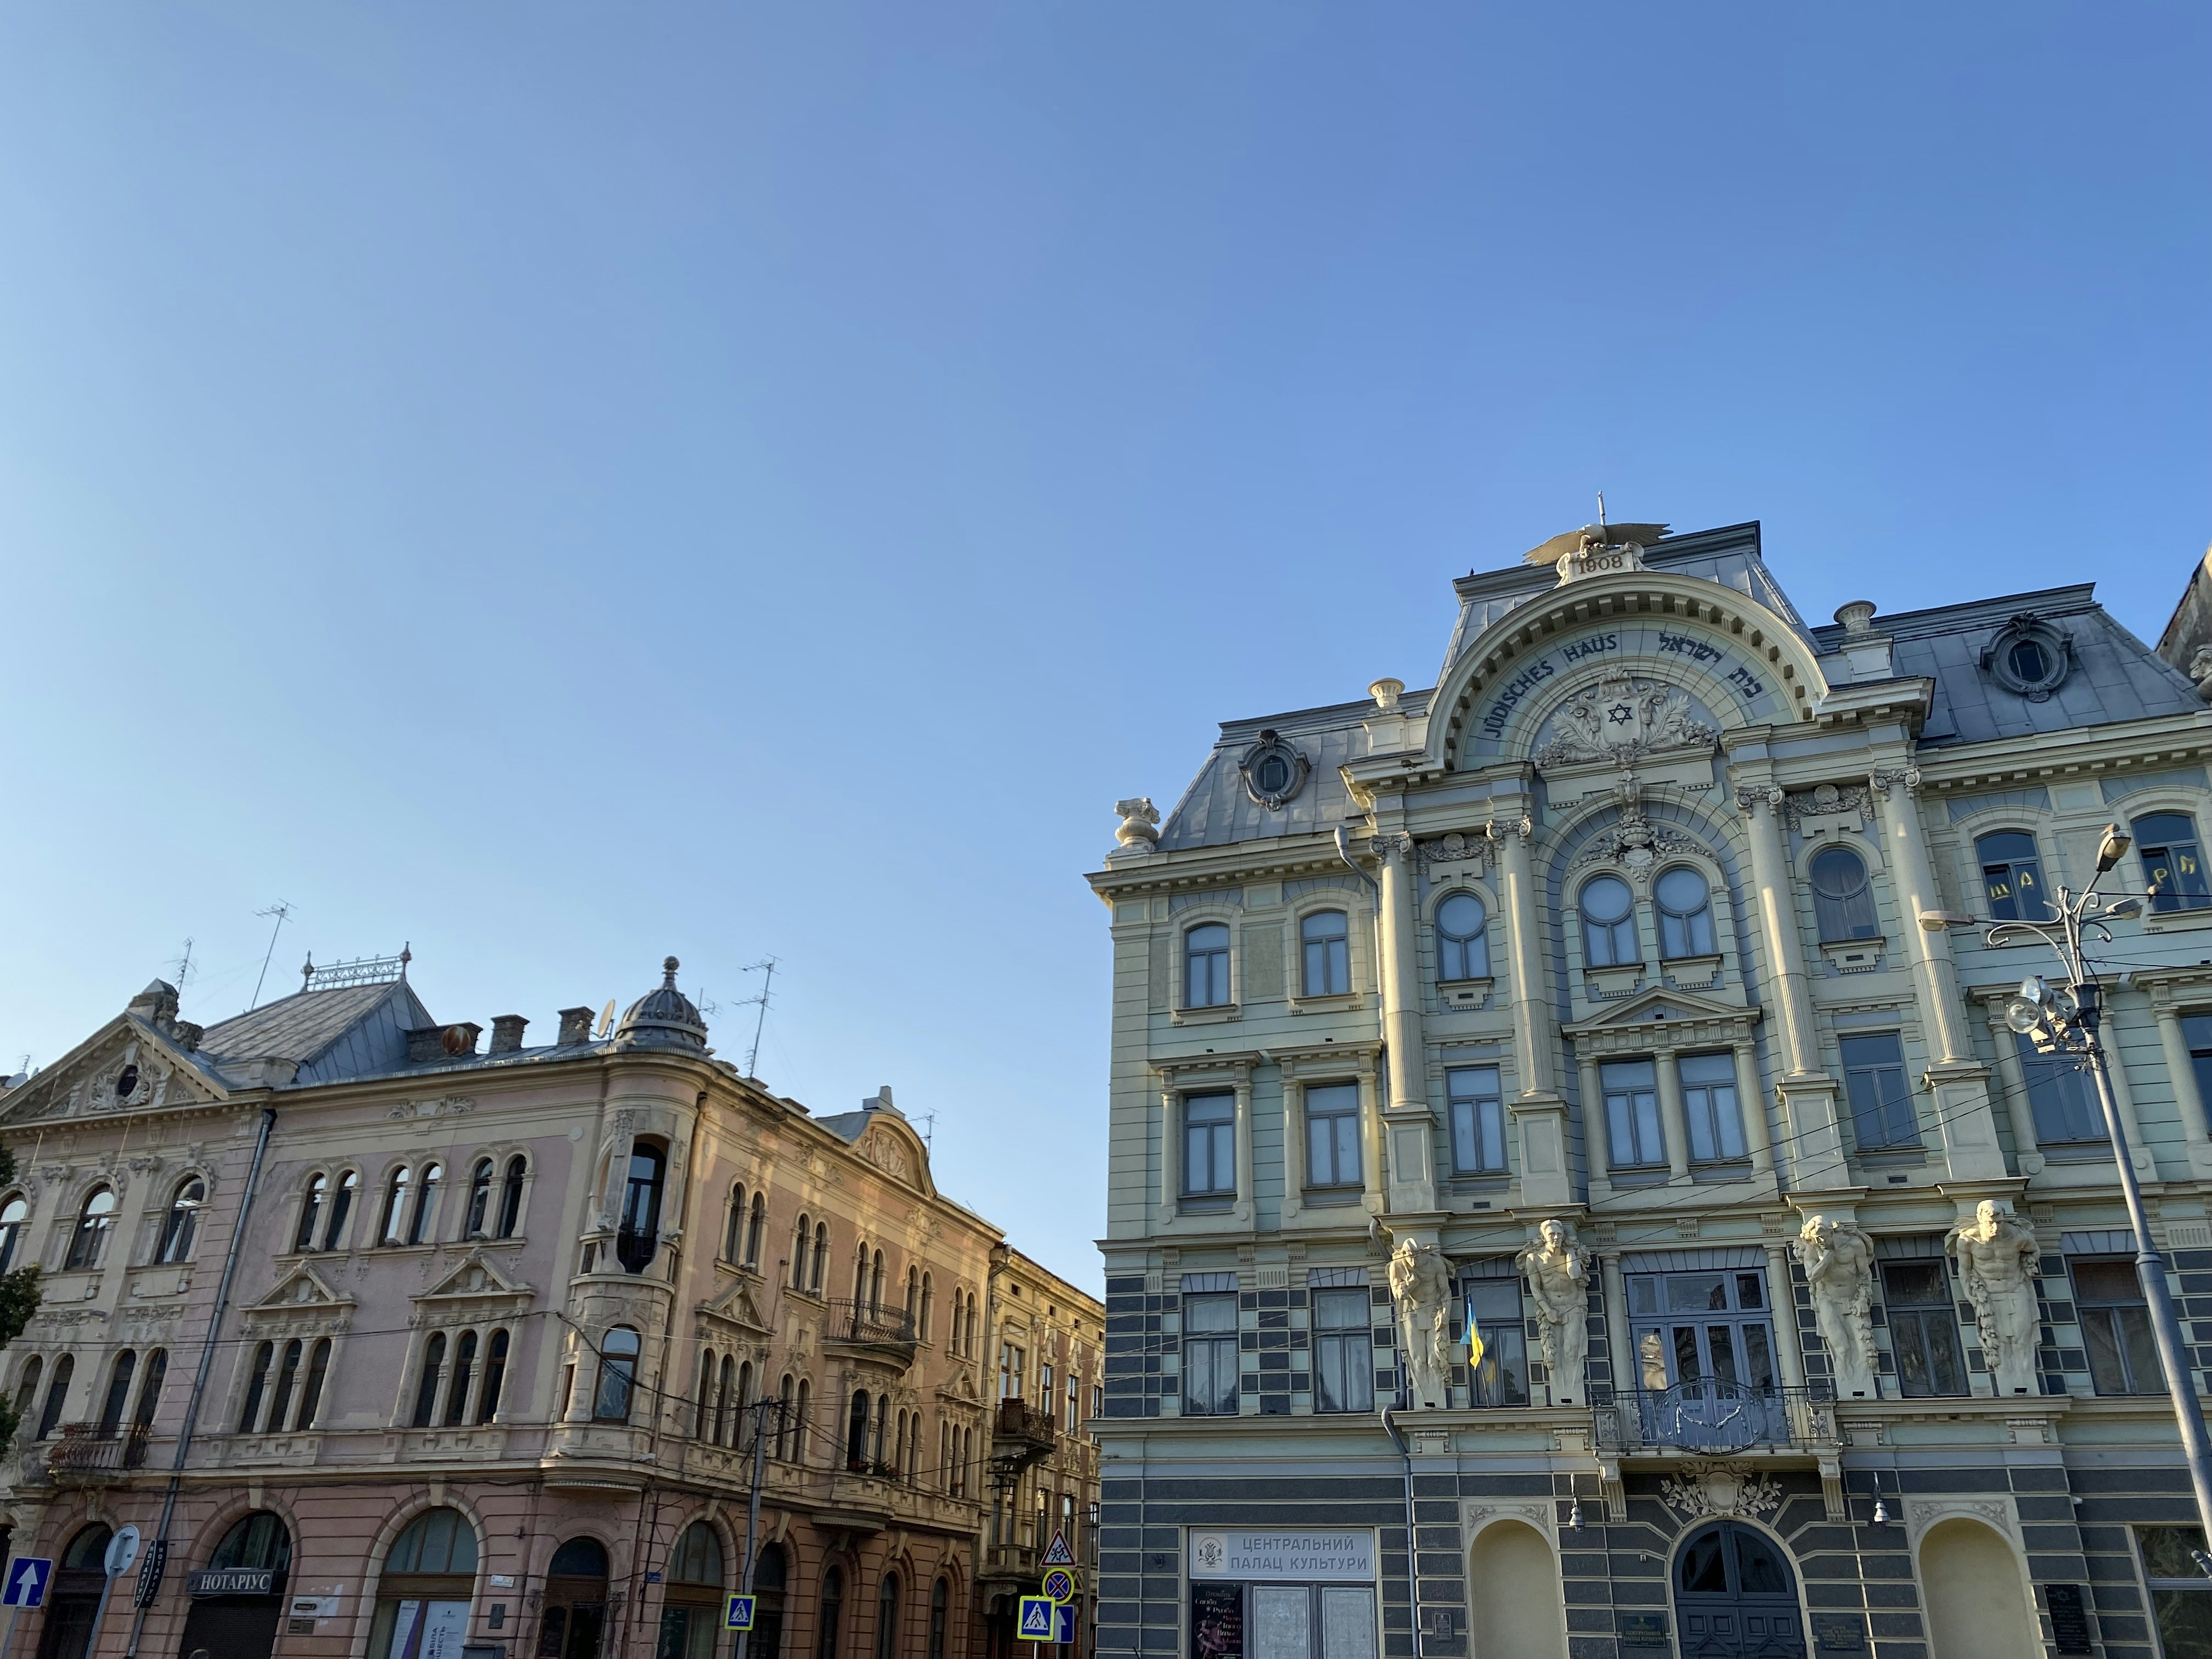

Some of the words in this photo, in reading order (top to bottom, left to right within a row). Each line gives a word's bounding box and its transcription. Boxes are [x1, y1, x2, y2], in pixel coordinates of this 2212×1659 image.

[1578, 555, 1623, 574] 1908
[1659, 631, 1722, 663] ישראל
[1483, 660, 1554, 738] JÜDISCHES
[1564, 634, 1617, 662] HAUS
[1728, 667, 1762, 698] בית
[1243, 1535, 1354, 1553] ЦЕНТРАЛЬНИЙ
[1231, 1556, 1283, 1572] ПАЛАЦ
[1290, 1557, 1367, 1570] КУЛЬТУРИ
[200, 1574, 270, 1590] НОТАРІУС
